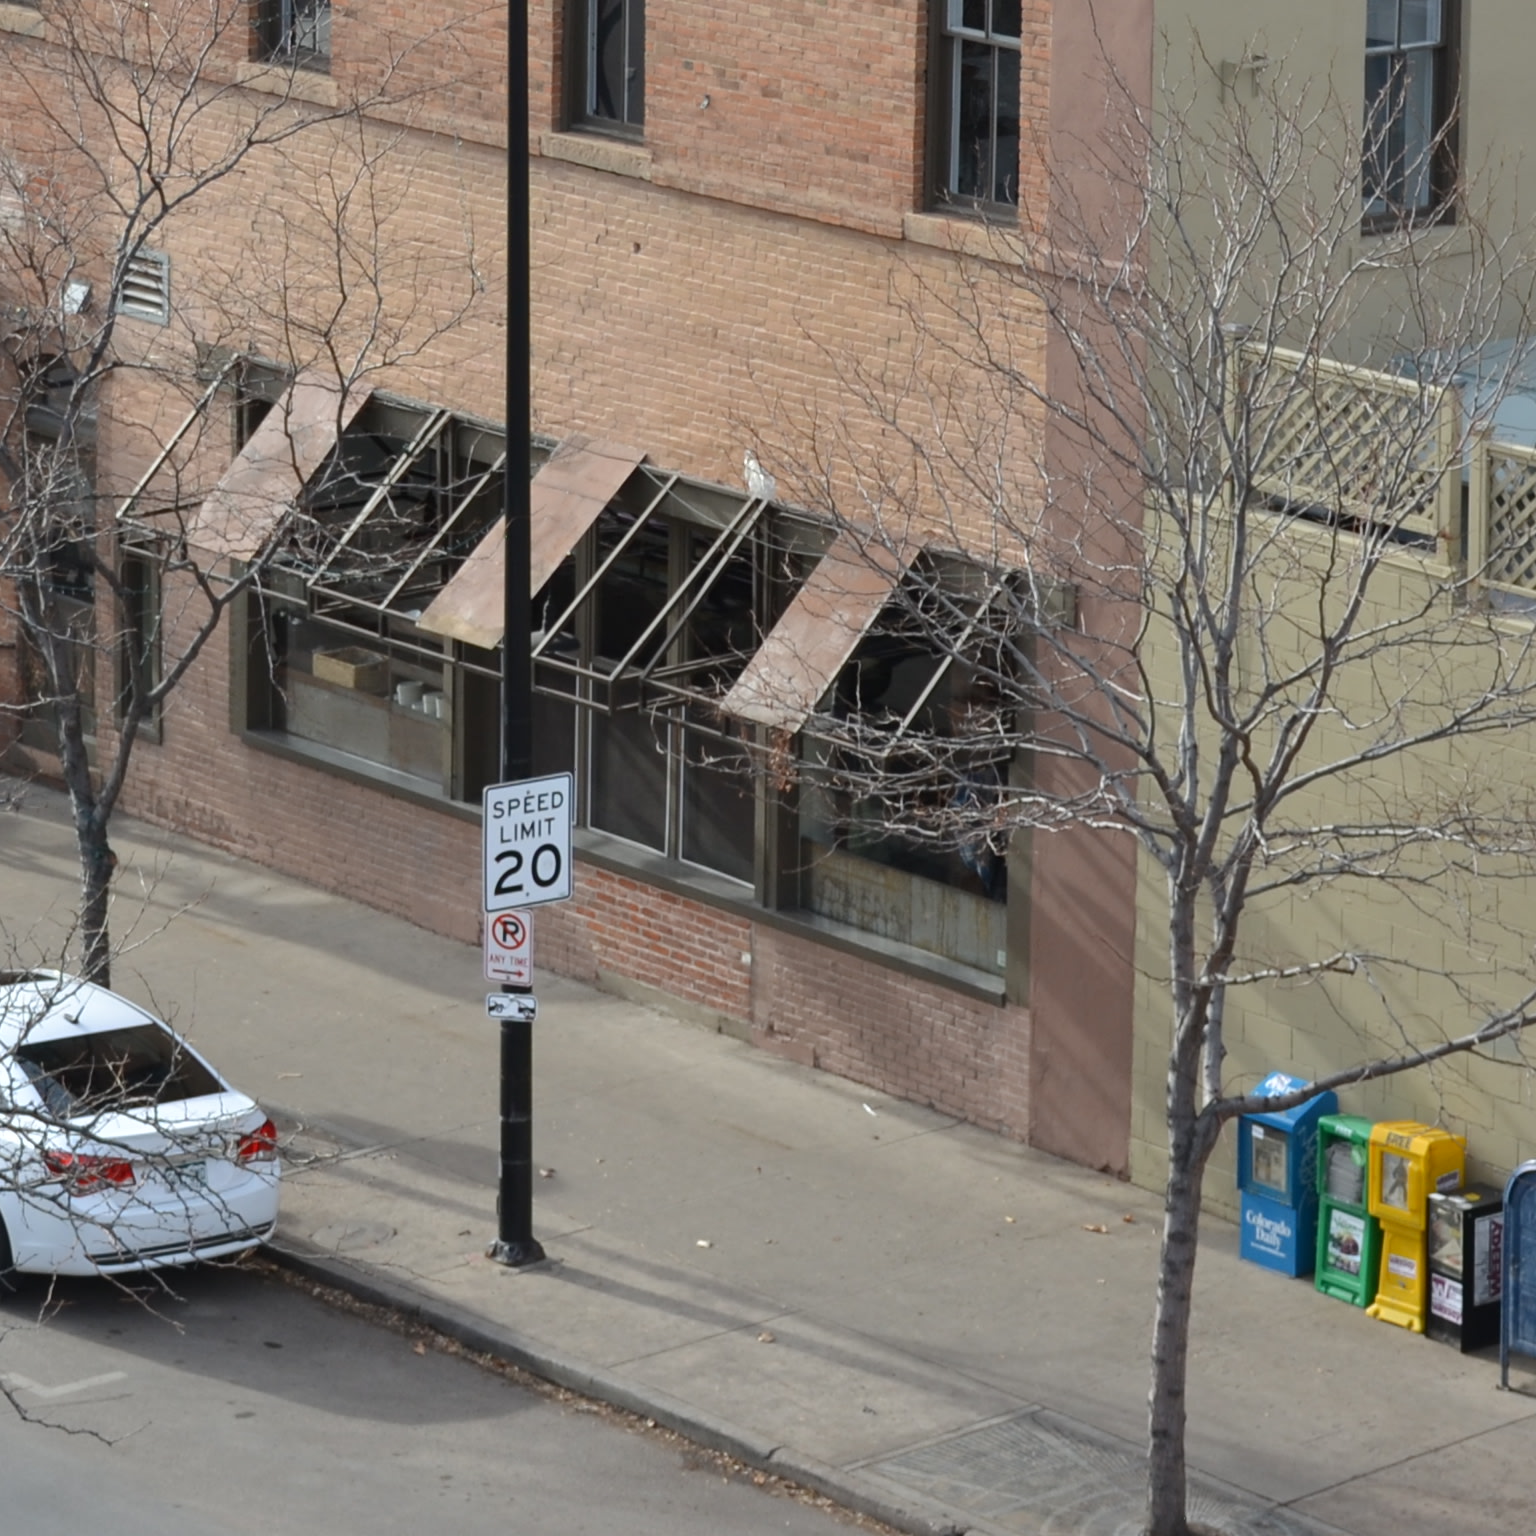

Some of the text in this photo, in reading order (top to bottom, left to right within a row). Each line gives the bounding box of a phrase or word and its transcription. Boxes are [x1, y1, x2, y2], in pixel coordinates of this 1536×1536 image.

[492, 791, 565, 820] SPEED
[500, 818, 556, 844] LIMIT
[493, 843, 562, 897] 20
[489, 954, 528, 967] ANY TIME
[1385, 1131, 1413, 1151] FREE
[1245, 1209, 1292, 1238] Colorado
[1255, 1227, 1282, 1251] Daily
